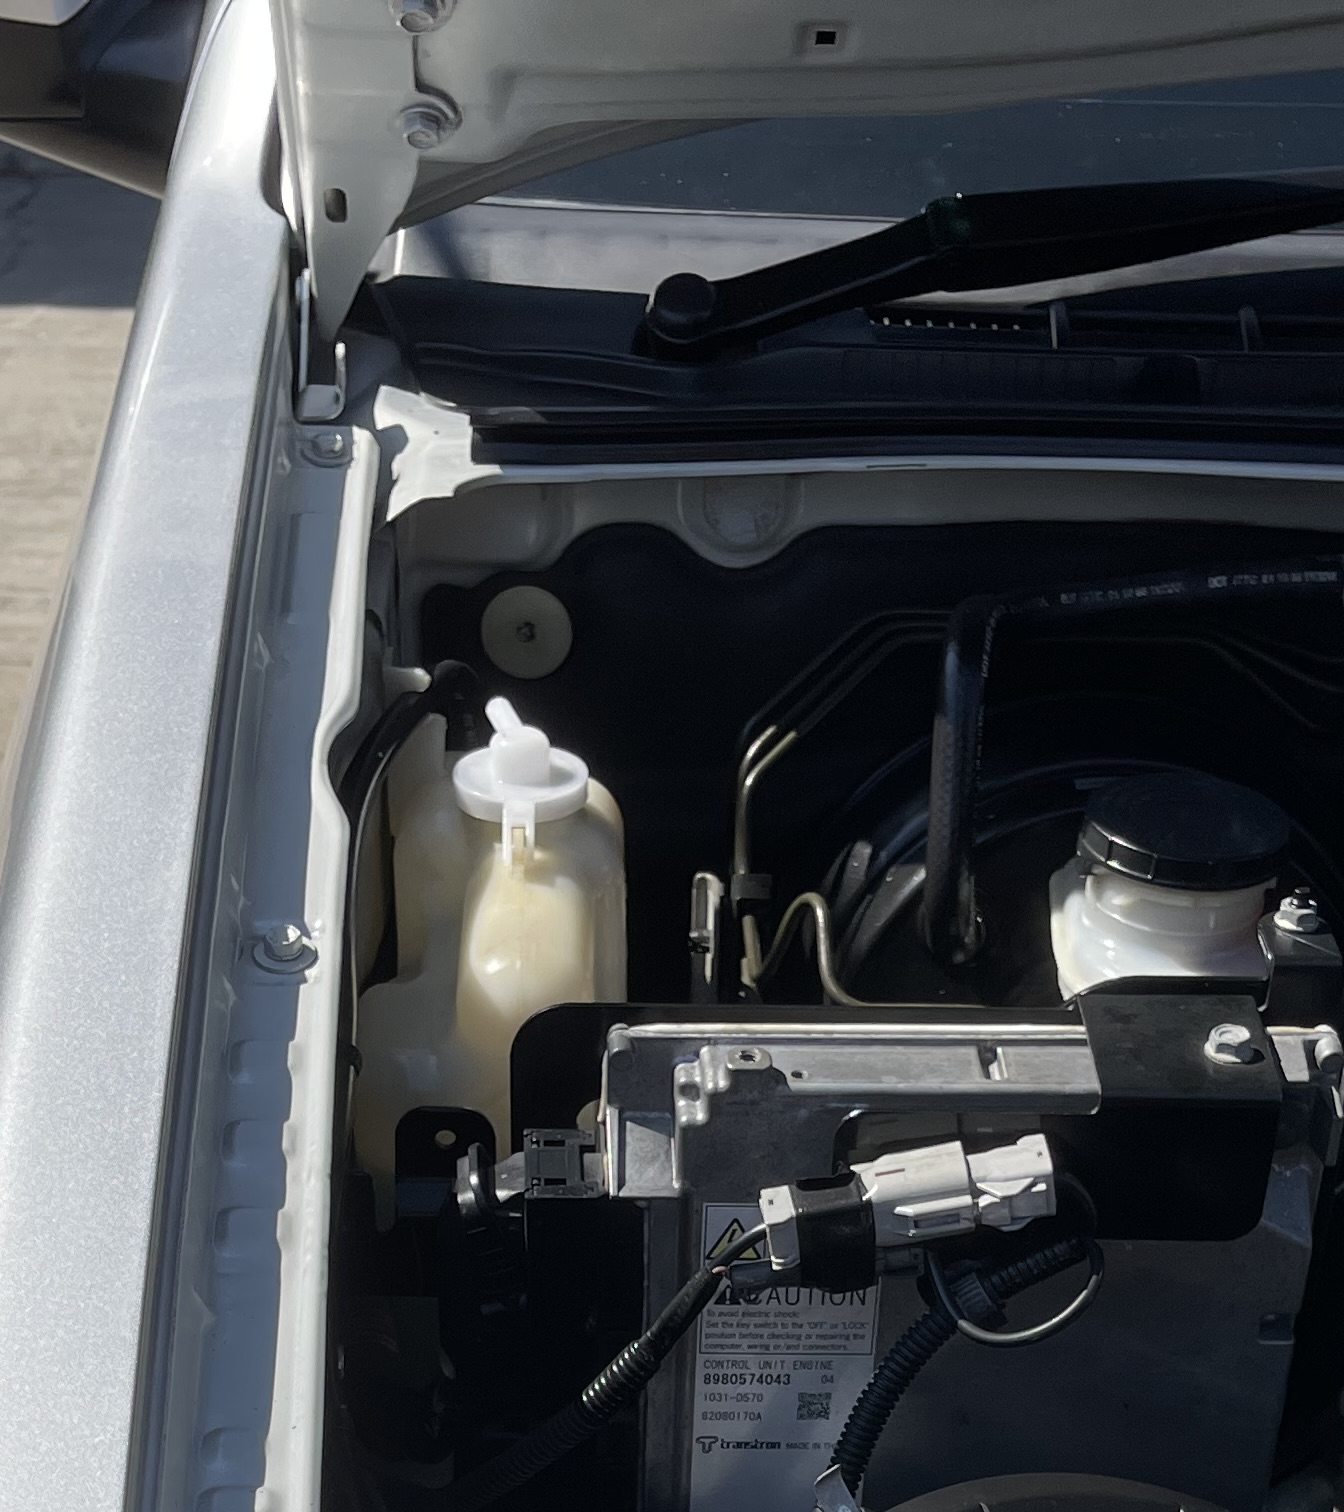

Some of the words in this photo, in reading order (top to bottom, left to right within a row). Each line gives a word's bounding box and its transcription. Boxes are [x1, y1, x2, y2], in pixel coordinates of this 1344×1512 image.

[703, 1360, 751, 1370] CONTROL
[758, 1360, 786, 1370] UNIT
[793, 1360, 834, 1370] ENGINE
[703, 1373, 791, 1385] 8980574043
[820, 1374, 834, 1384] 04
[720, 1438, 781, 1450] transtron
